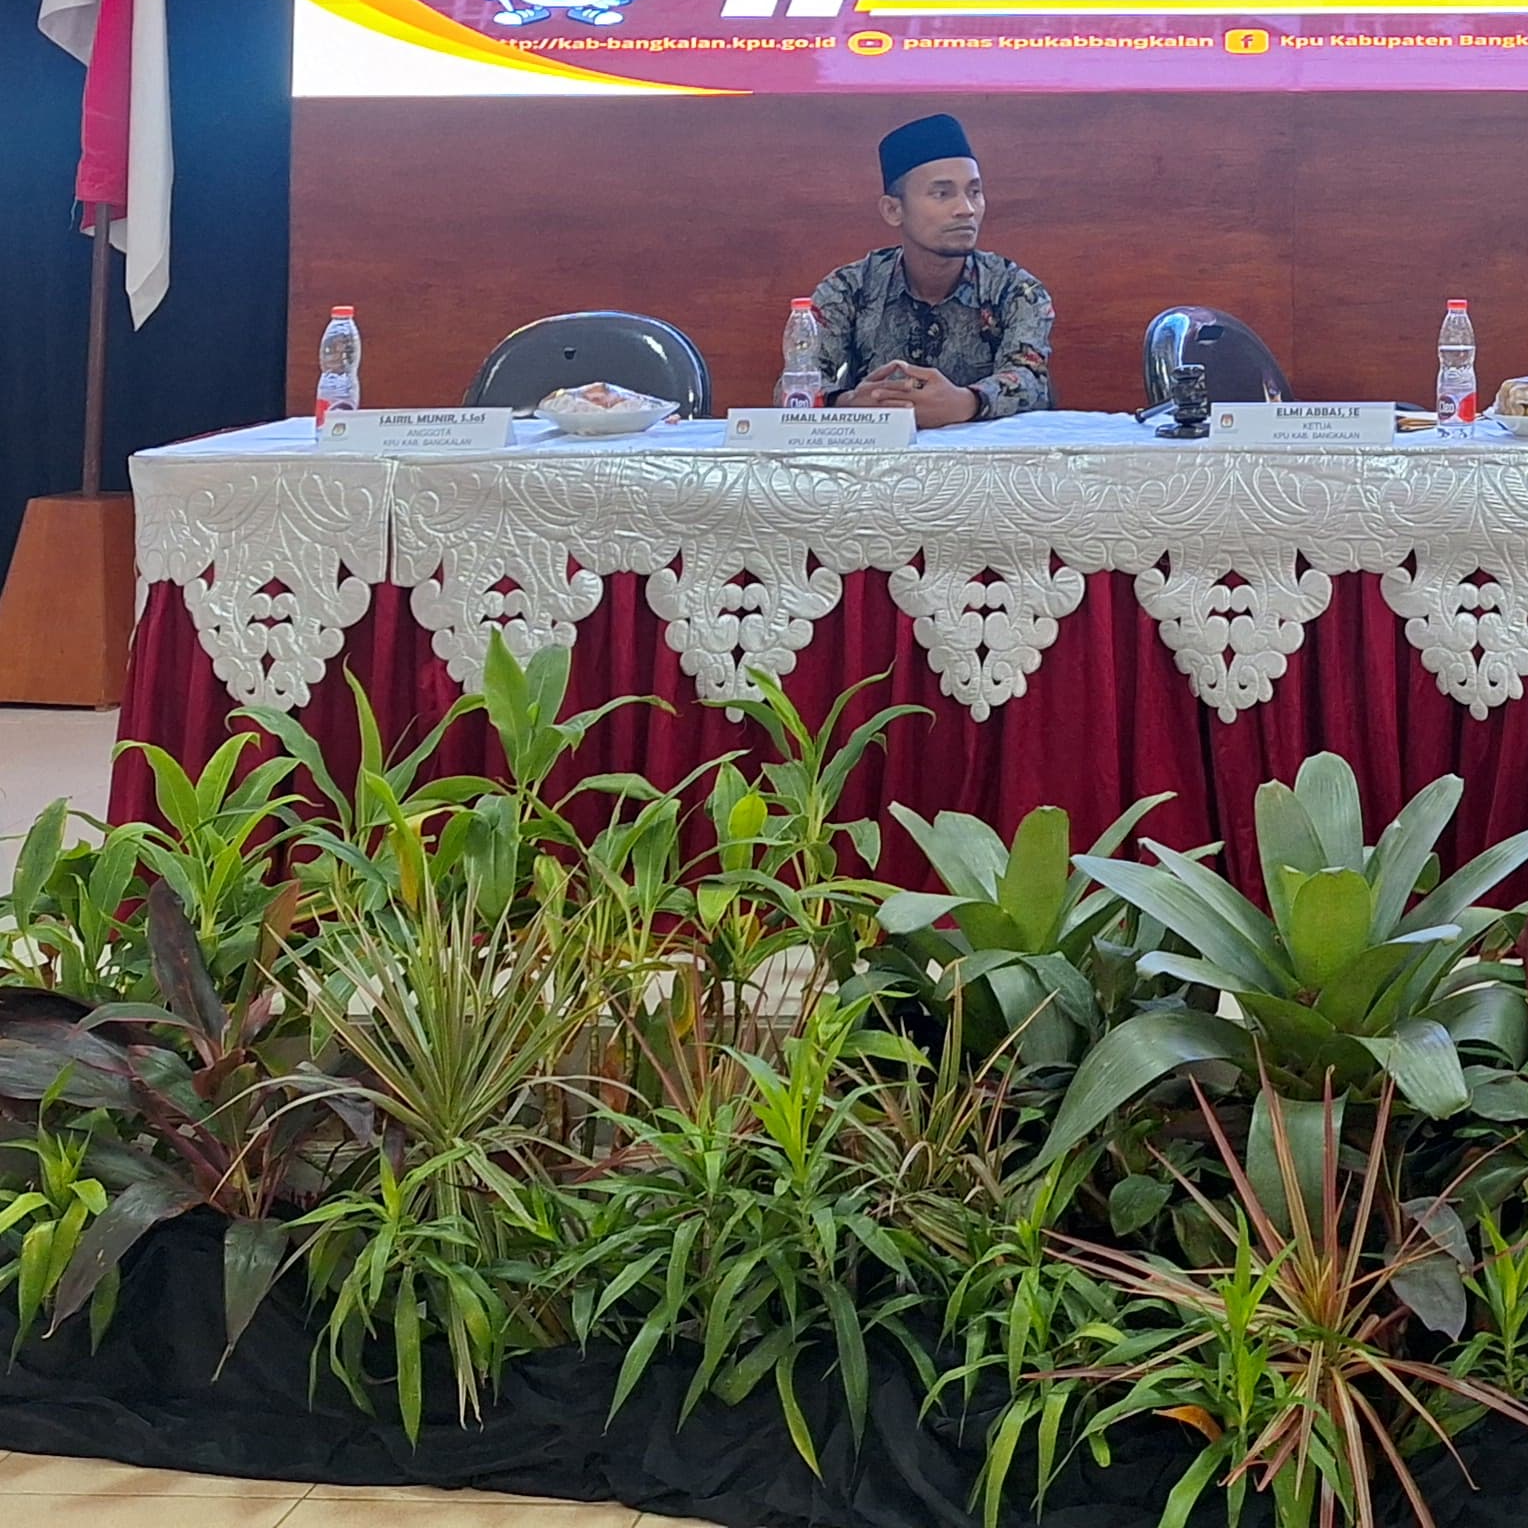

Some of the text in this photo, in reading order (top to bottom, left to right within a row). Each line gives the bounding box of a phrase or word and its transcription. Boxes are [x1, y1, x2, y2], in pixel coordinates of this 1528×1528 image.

[500, 36, 837, 52] tp://kab-bangkalan.kpu.go.id
[904, 35, 1214, 50] parmas kpukabbangkalan
[1280, 34, 1324, 48] Kpu
[1330, 34, 1453, 49] Kabupaten
[1276, 407, 1302, 416] ELMI
